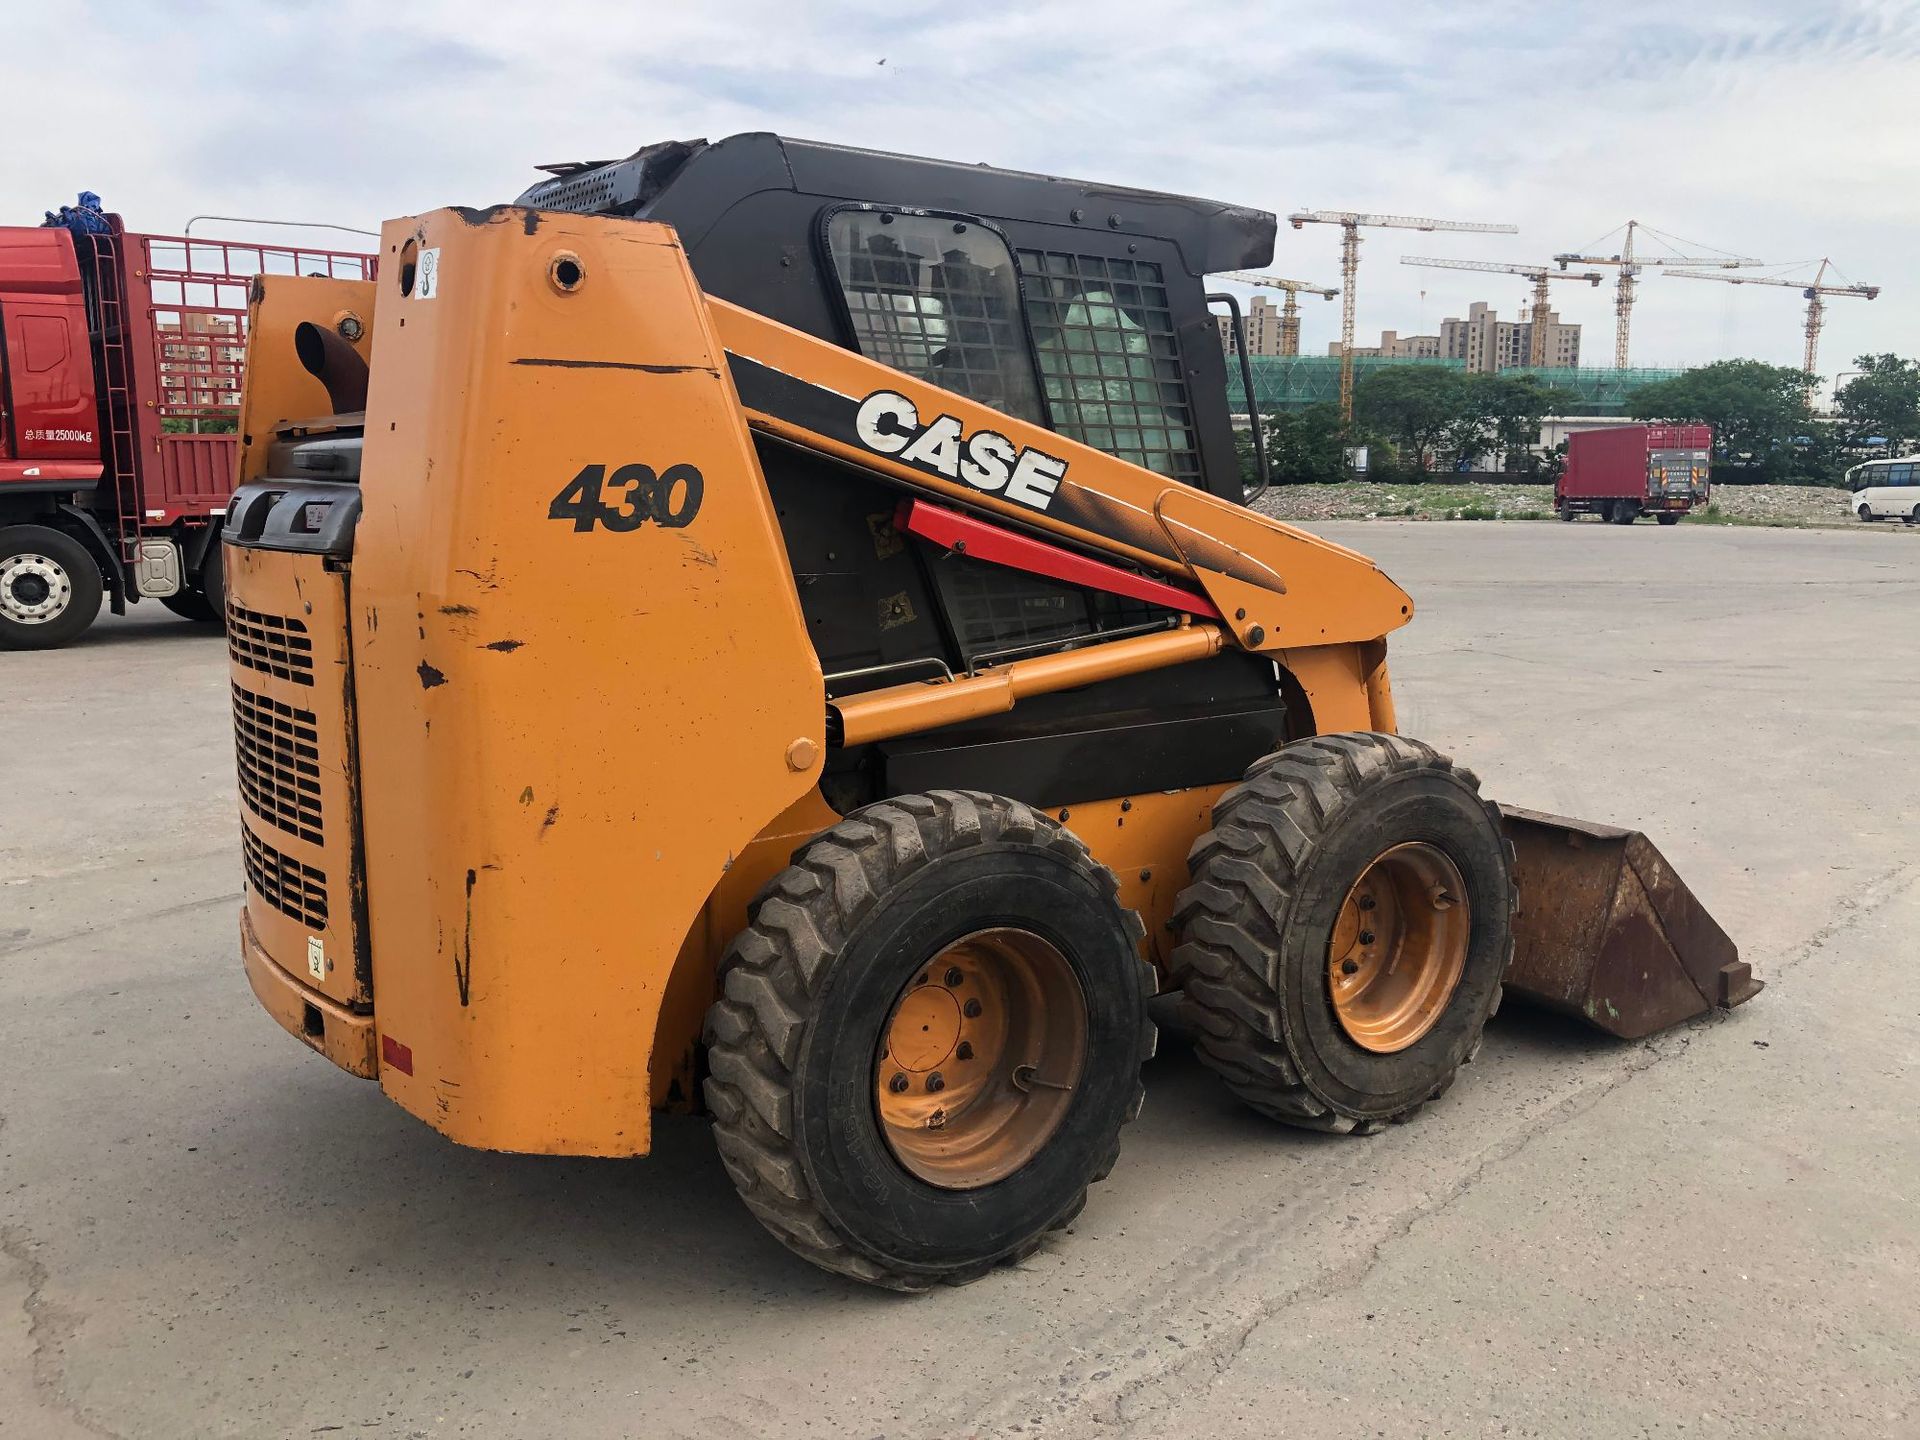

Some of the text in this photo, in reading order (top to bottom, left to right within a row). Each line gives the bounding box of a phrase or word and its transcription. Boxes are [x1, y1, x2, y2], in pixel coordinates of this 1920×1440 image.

[24, 428, 92, 443] 总质量25000kg
[855, 391, 1068, 511] CASE
[548, 463, 704, 533] 430
